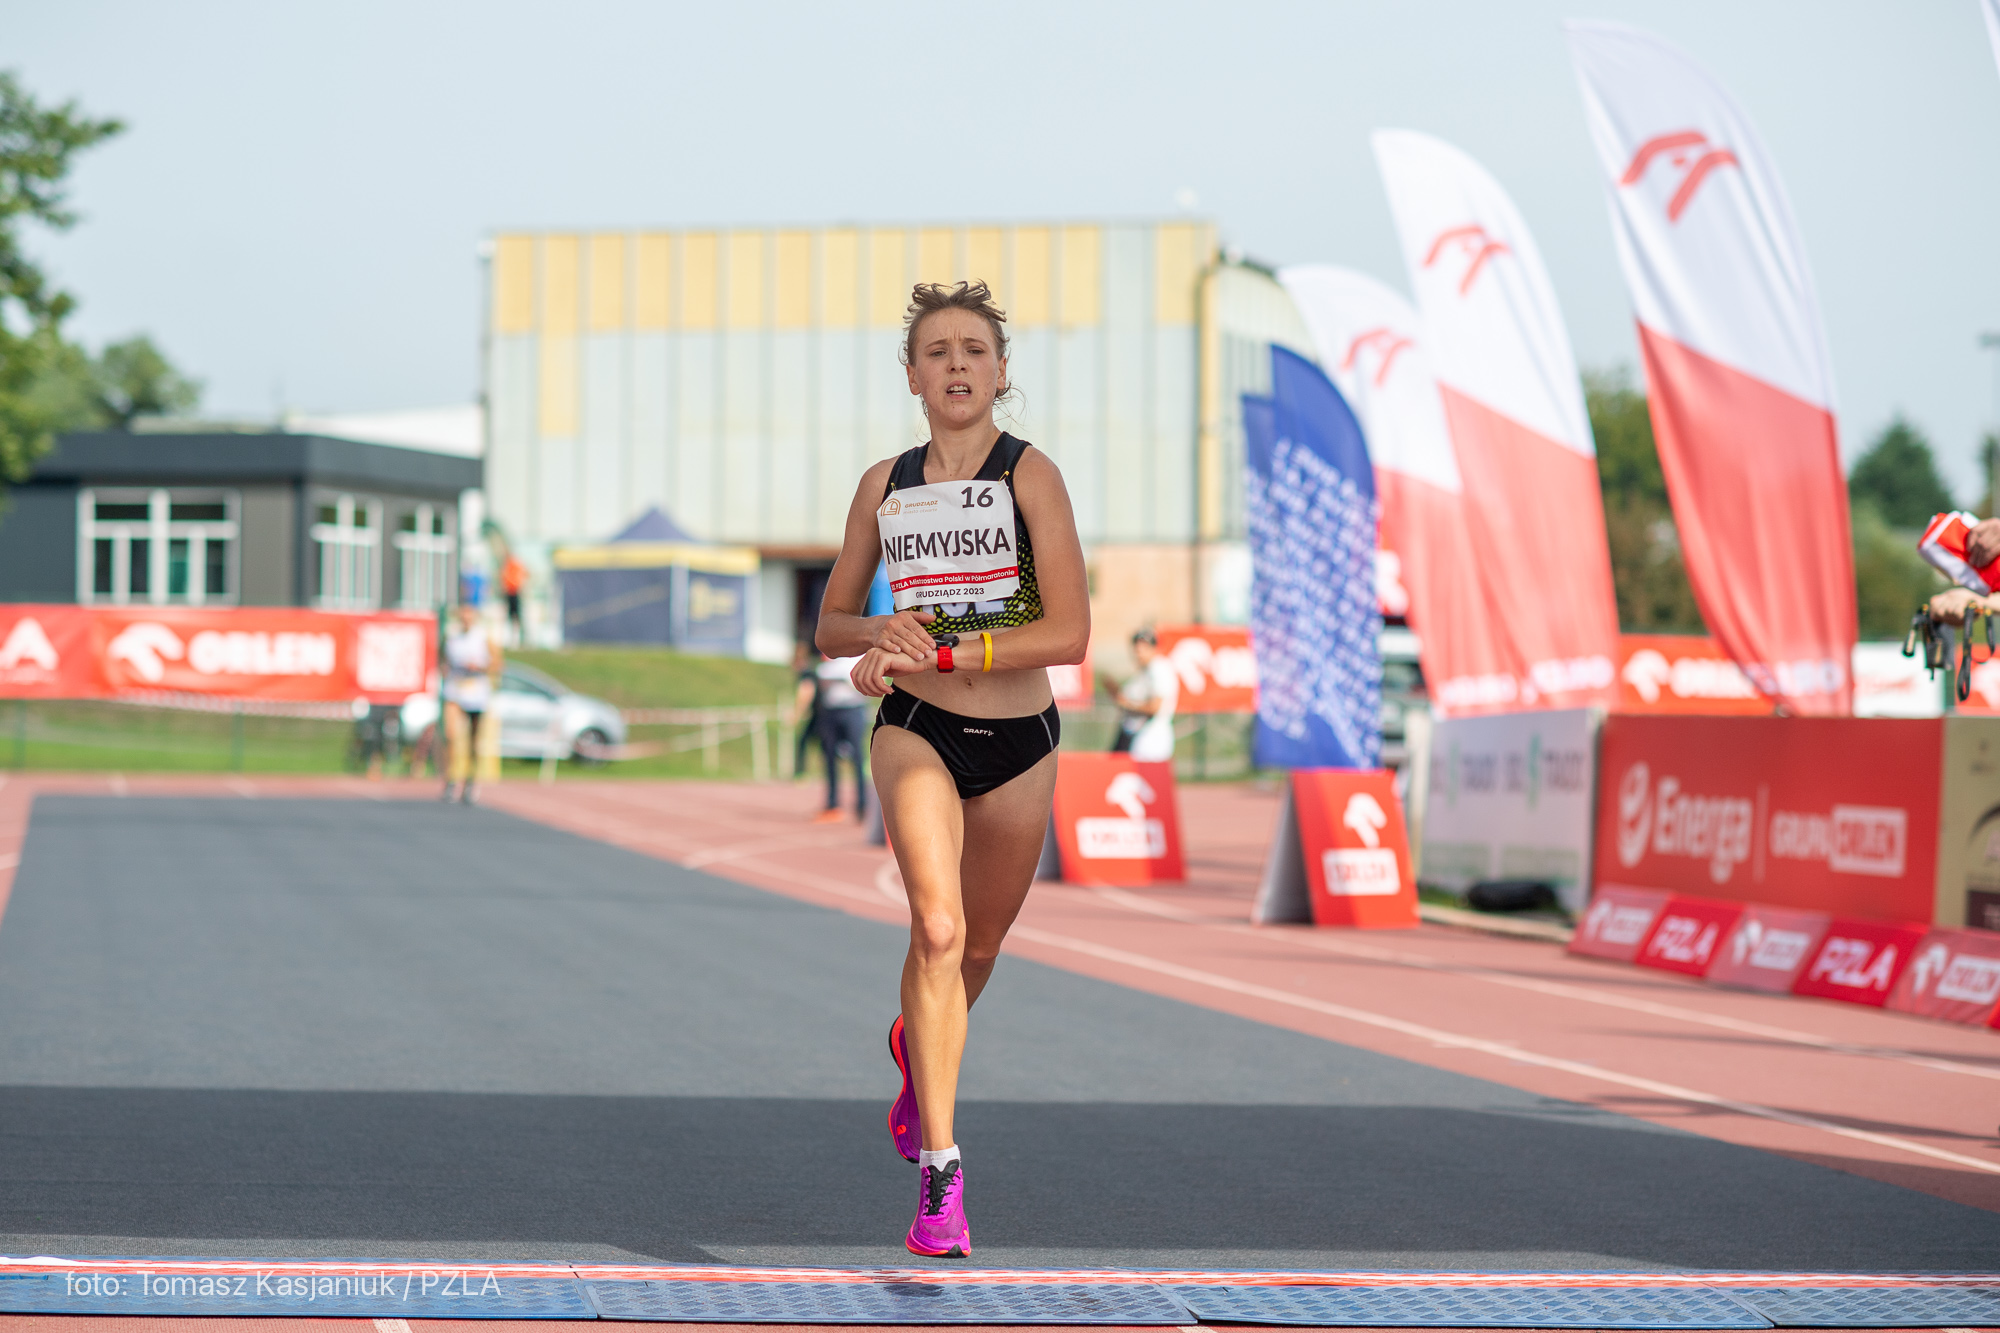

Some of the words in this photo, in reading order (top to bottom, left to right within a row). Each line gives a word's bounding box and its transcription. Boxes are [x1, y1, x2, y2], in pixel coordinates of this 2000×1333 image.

[961, 486, 994, 508] 16
[884, 527, 1011, 565] NIEMYJSKA
[944, 575, 964, 583] Polski
[971, 569, 1015, 582] Półmaratonie
[916, 589, 961, 598] GRUDZIĄDZ
[963, 587, 985, 595] 2023
[963, 727, 988, 735] CRAFT
[1655, 775, 1752, 884] Energa
